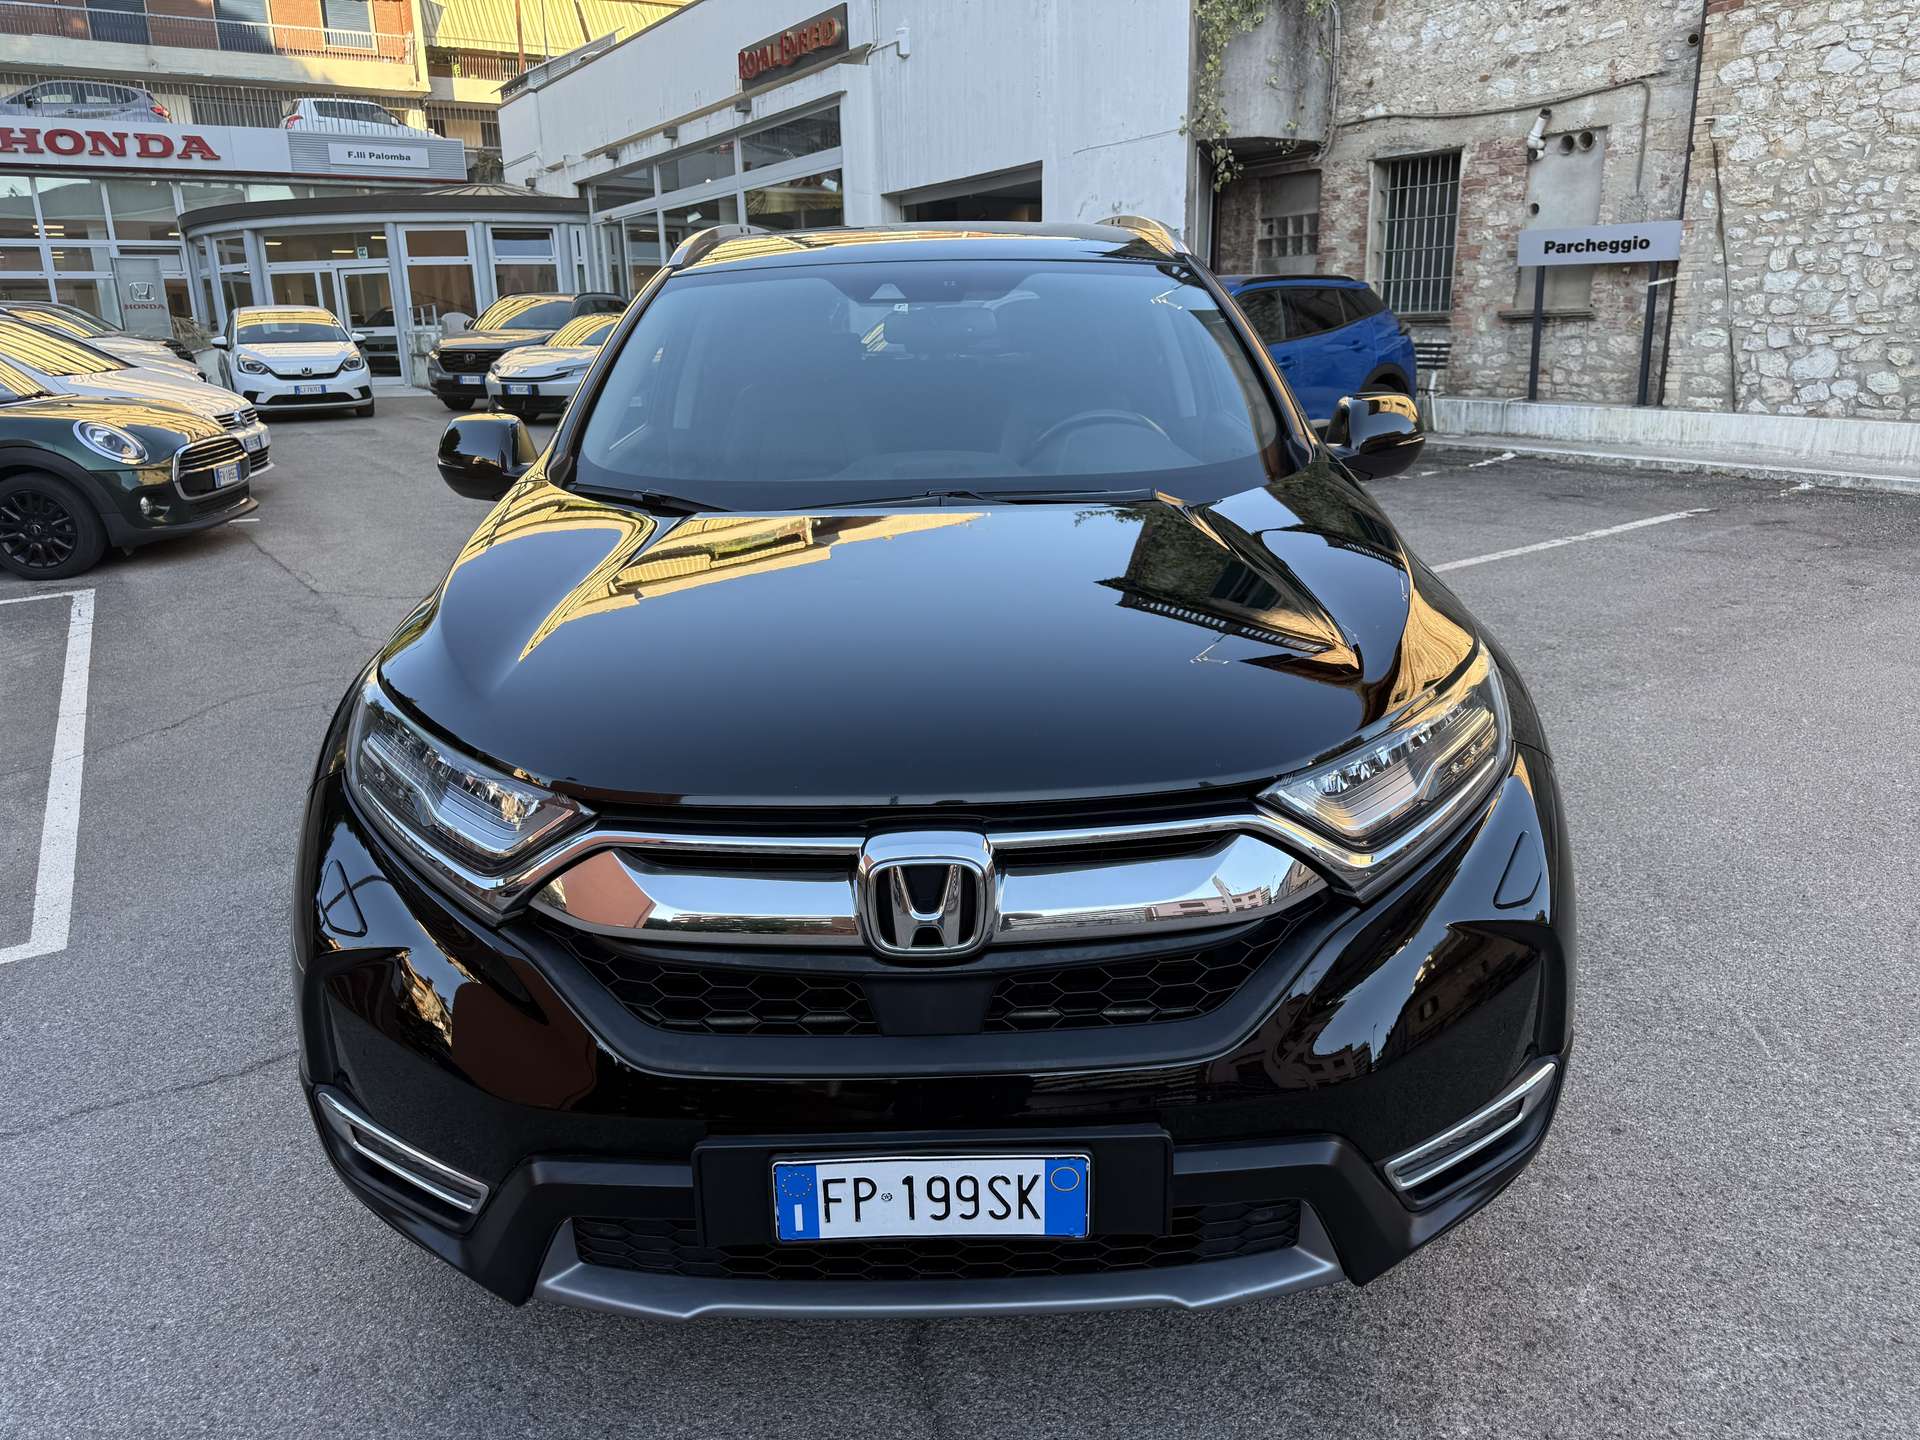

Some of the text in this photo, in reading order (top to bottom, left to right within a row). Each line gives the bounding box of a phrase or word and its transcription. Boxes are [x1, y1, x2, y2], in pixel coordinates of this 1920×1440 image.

[738, 43, 778, 80] ROYAL
[0, 127, 221, 160] HONDA
[368, 152, 411, 161] Palomba
[1544, 236, 1650, 254] Parcheggio
